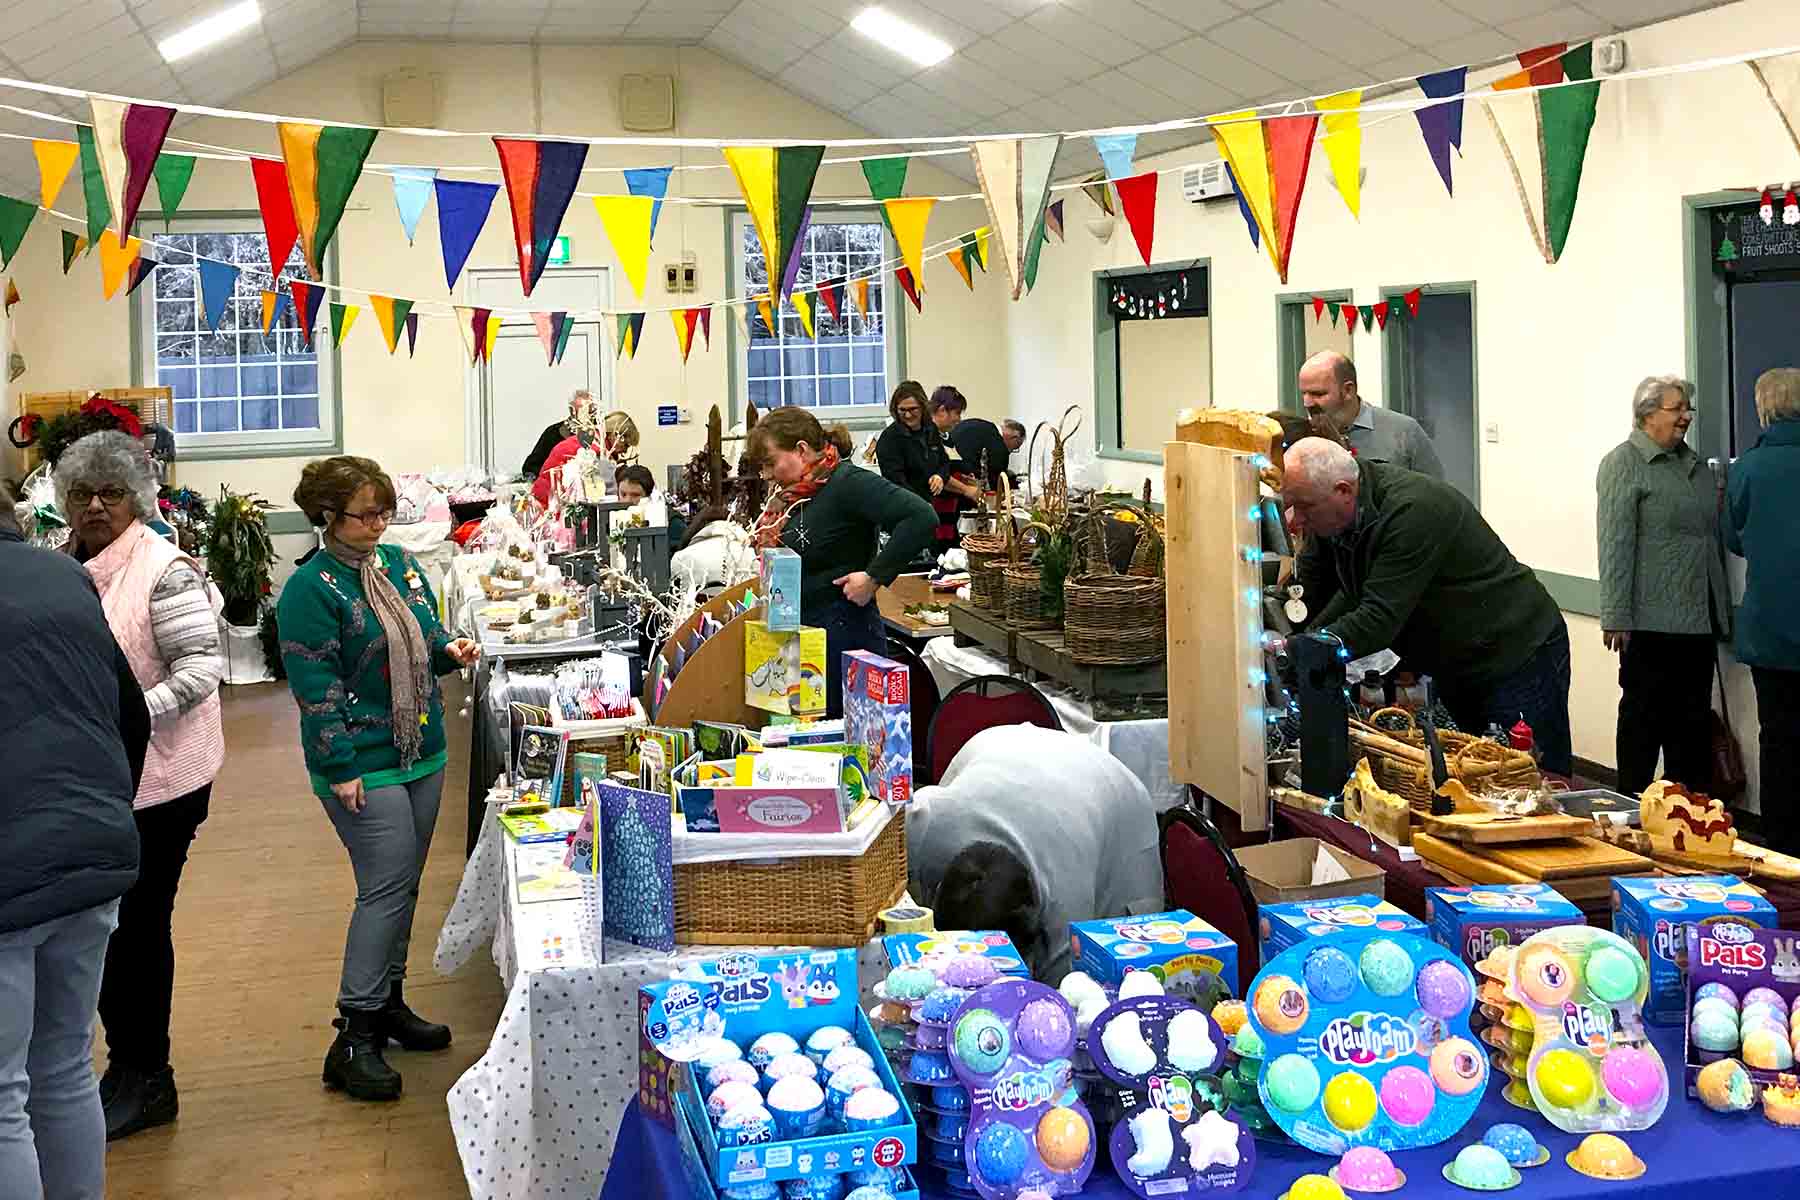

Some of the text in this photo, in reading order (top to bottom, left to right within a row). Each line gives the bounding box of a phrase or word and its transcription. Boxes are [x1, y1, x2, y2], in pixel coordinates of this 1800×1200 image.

[1743, 246, 1762, 256] FRUIT
[1764, 241, 1794, 256] SHOOTS
[896, 672, 904, 704] JIGSAW
